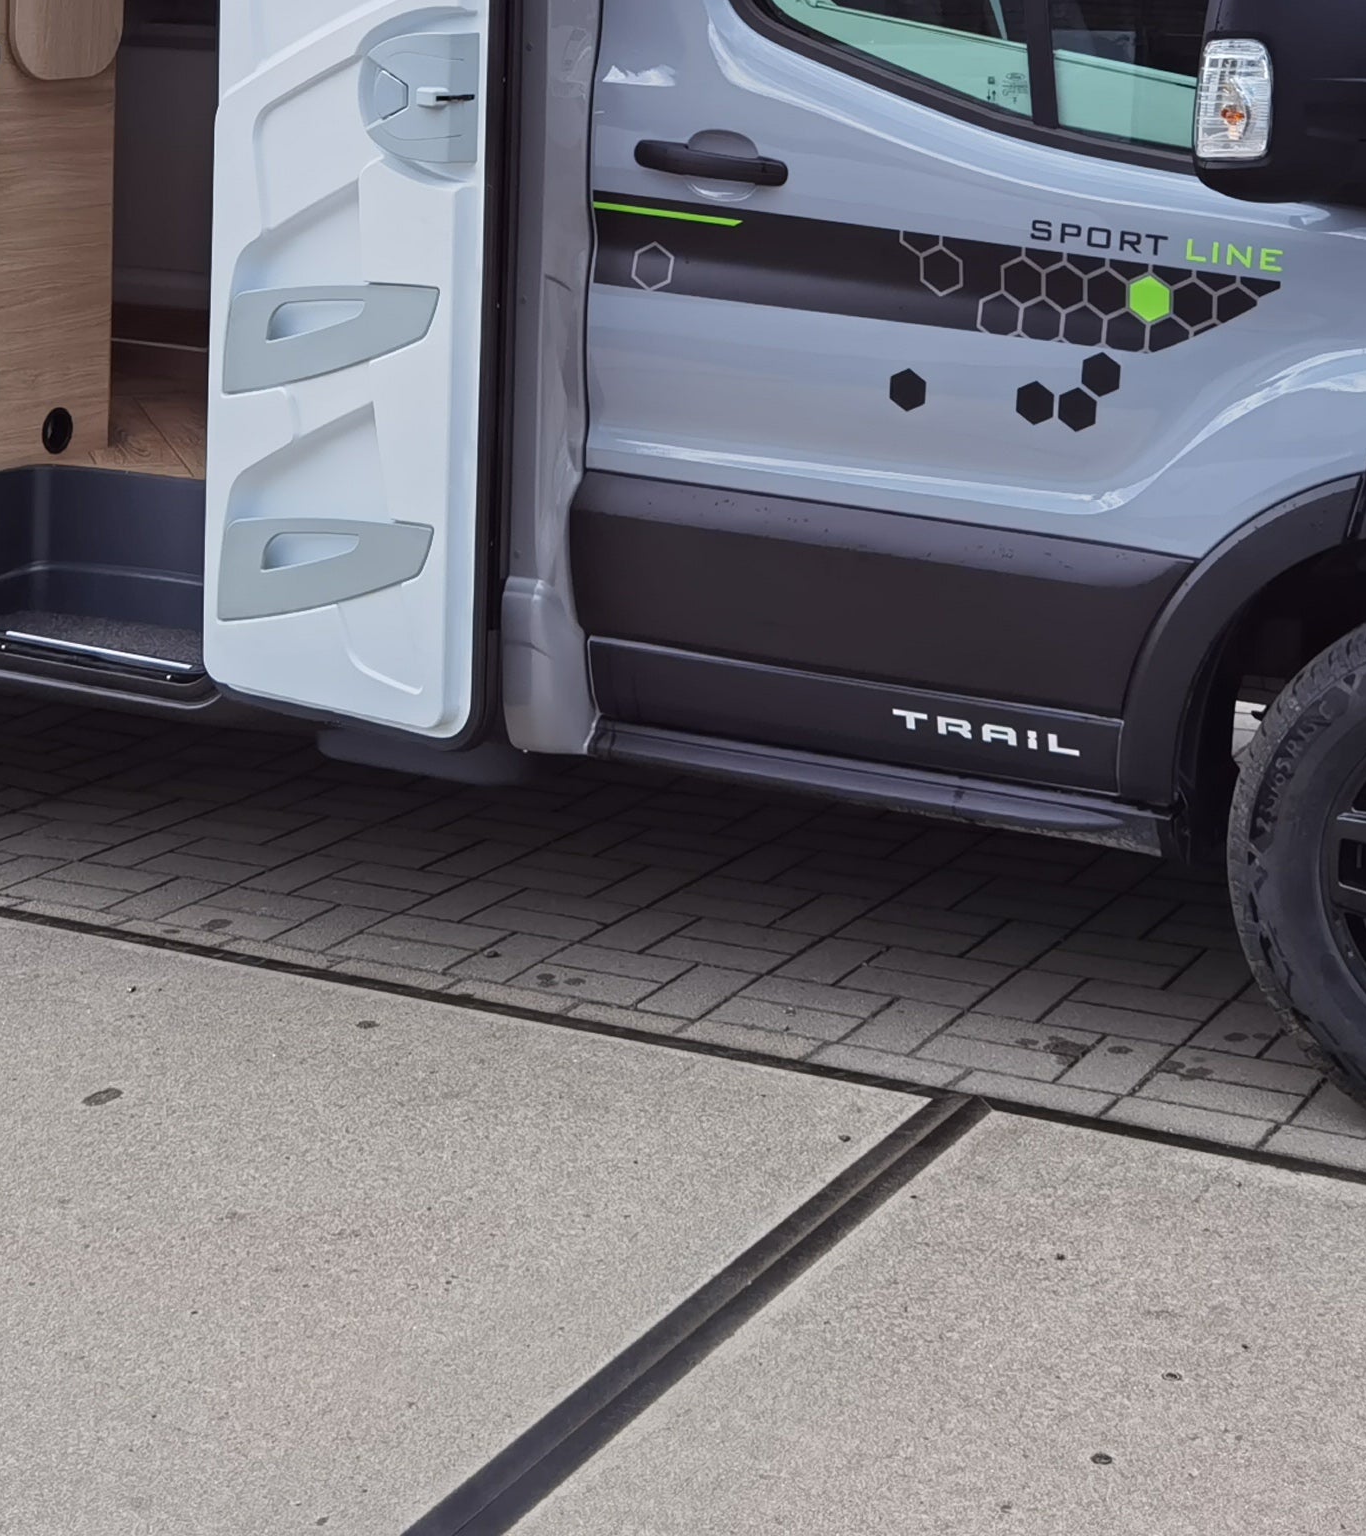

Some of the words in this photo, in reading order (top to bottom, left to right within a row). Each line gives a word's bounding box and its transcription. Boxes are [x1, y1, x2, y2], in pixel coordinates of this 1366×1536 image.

[1030, 219, 1169, 256] SPORT
[1186, 238, 1285, 272] LINE
[891, 707, 1081, 757] TRAIL
